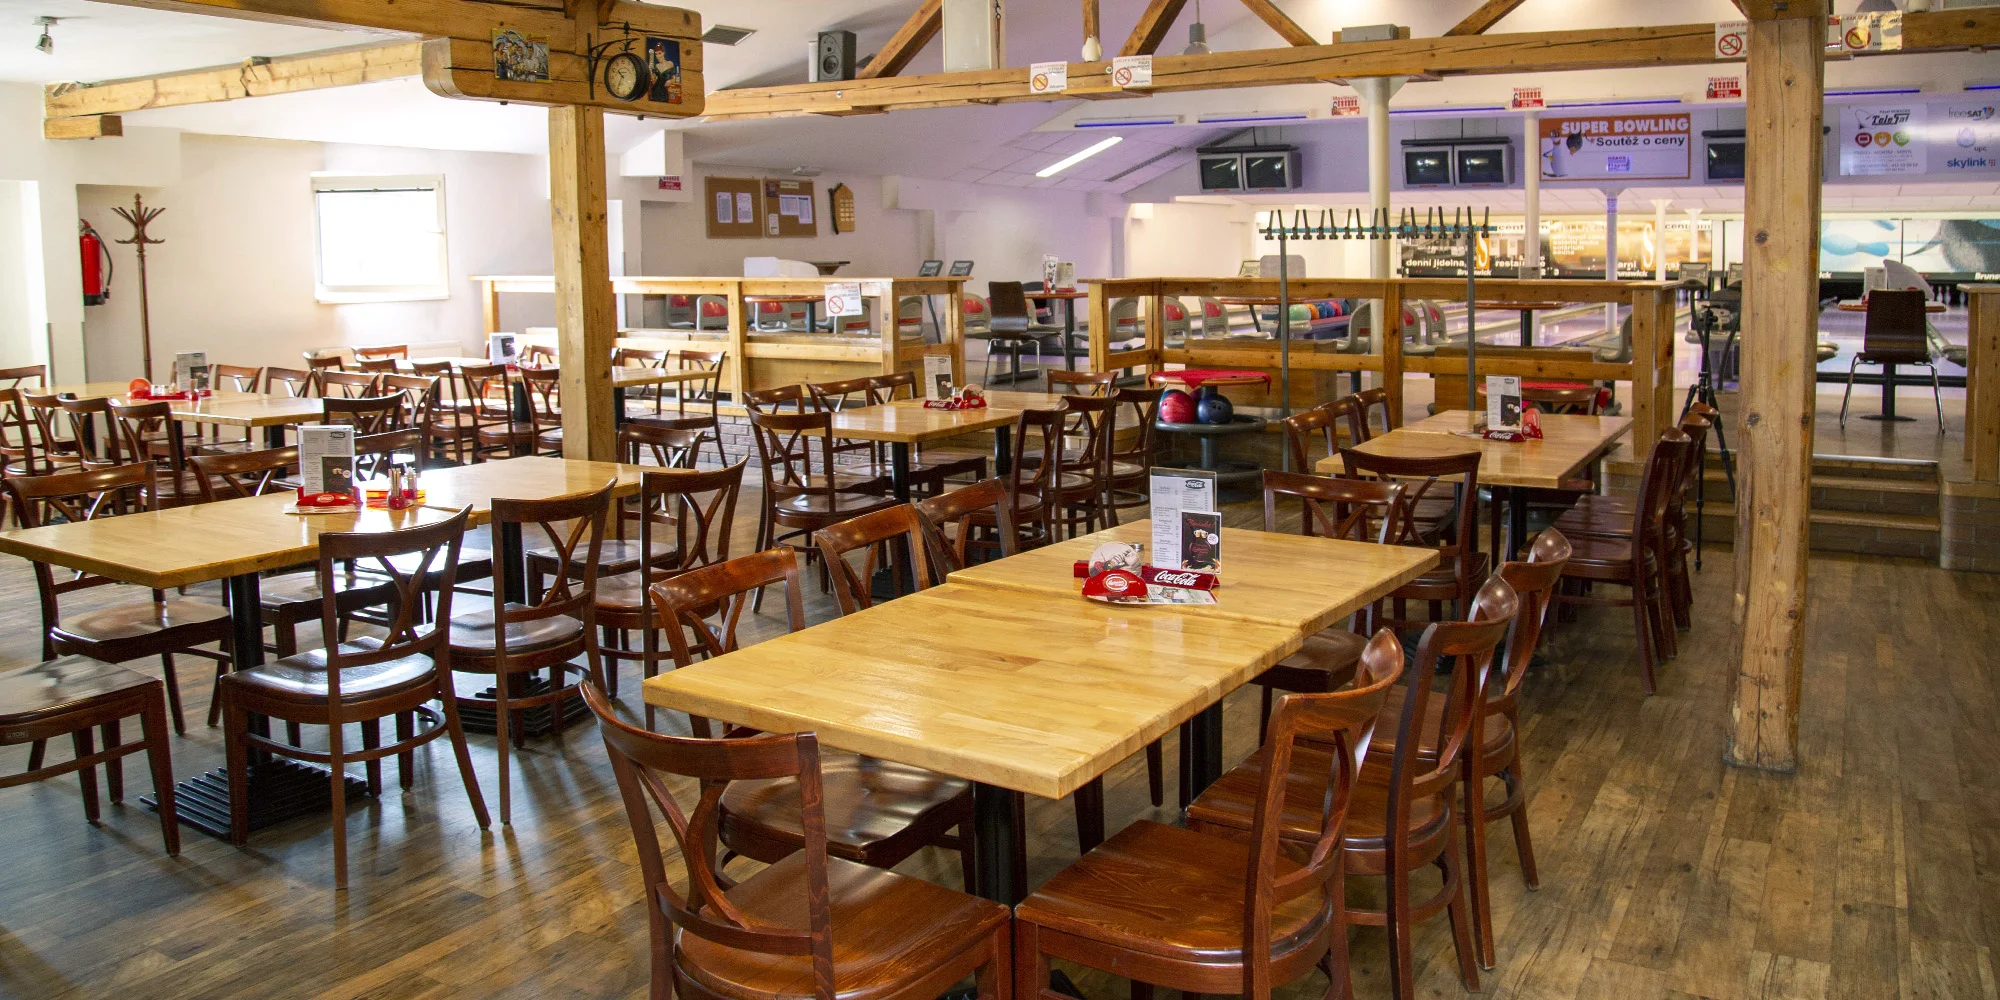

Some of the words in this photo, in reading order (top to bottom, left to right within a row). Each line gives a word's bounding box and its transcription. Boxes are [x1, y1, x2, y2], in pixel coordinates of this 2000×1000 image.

[1561, 120, 1609, 135] SUPER
[1614, 117, 1689, 134] BOWLING
[1596, 137, 1639, 147] Soutěž
[1643, 138, 1651, 146] o
[1654, 136, 1685, 147] ceny
[1947, 158, 1987, 168] skylink
[1154, 570, 1201, 587] Coca-Cola
